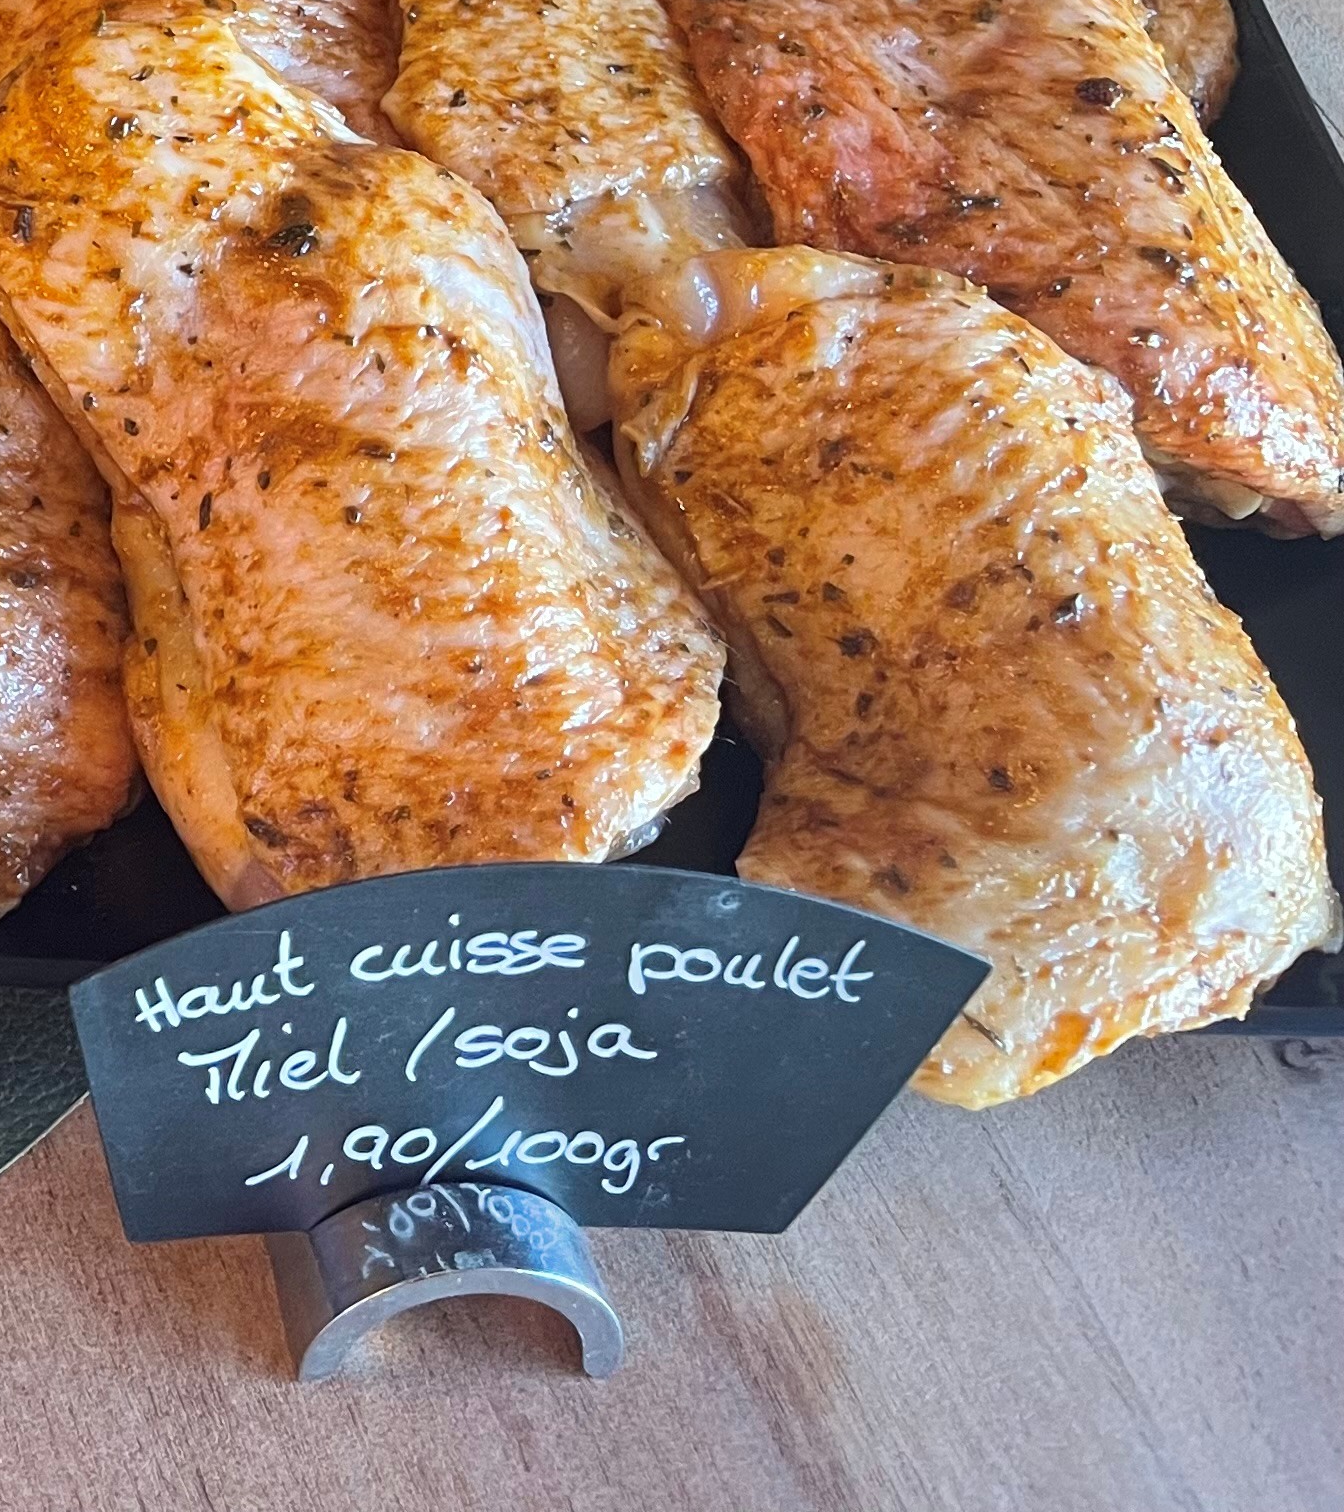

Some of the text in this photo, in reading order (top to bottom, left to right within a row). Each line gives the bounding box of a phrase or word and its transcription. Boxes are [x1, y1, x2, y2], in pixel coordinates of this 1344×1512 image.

[135, 914, 873, 1033] Haut cuisse poulet
